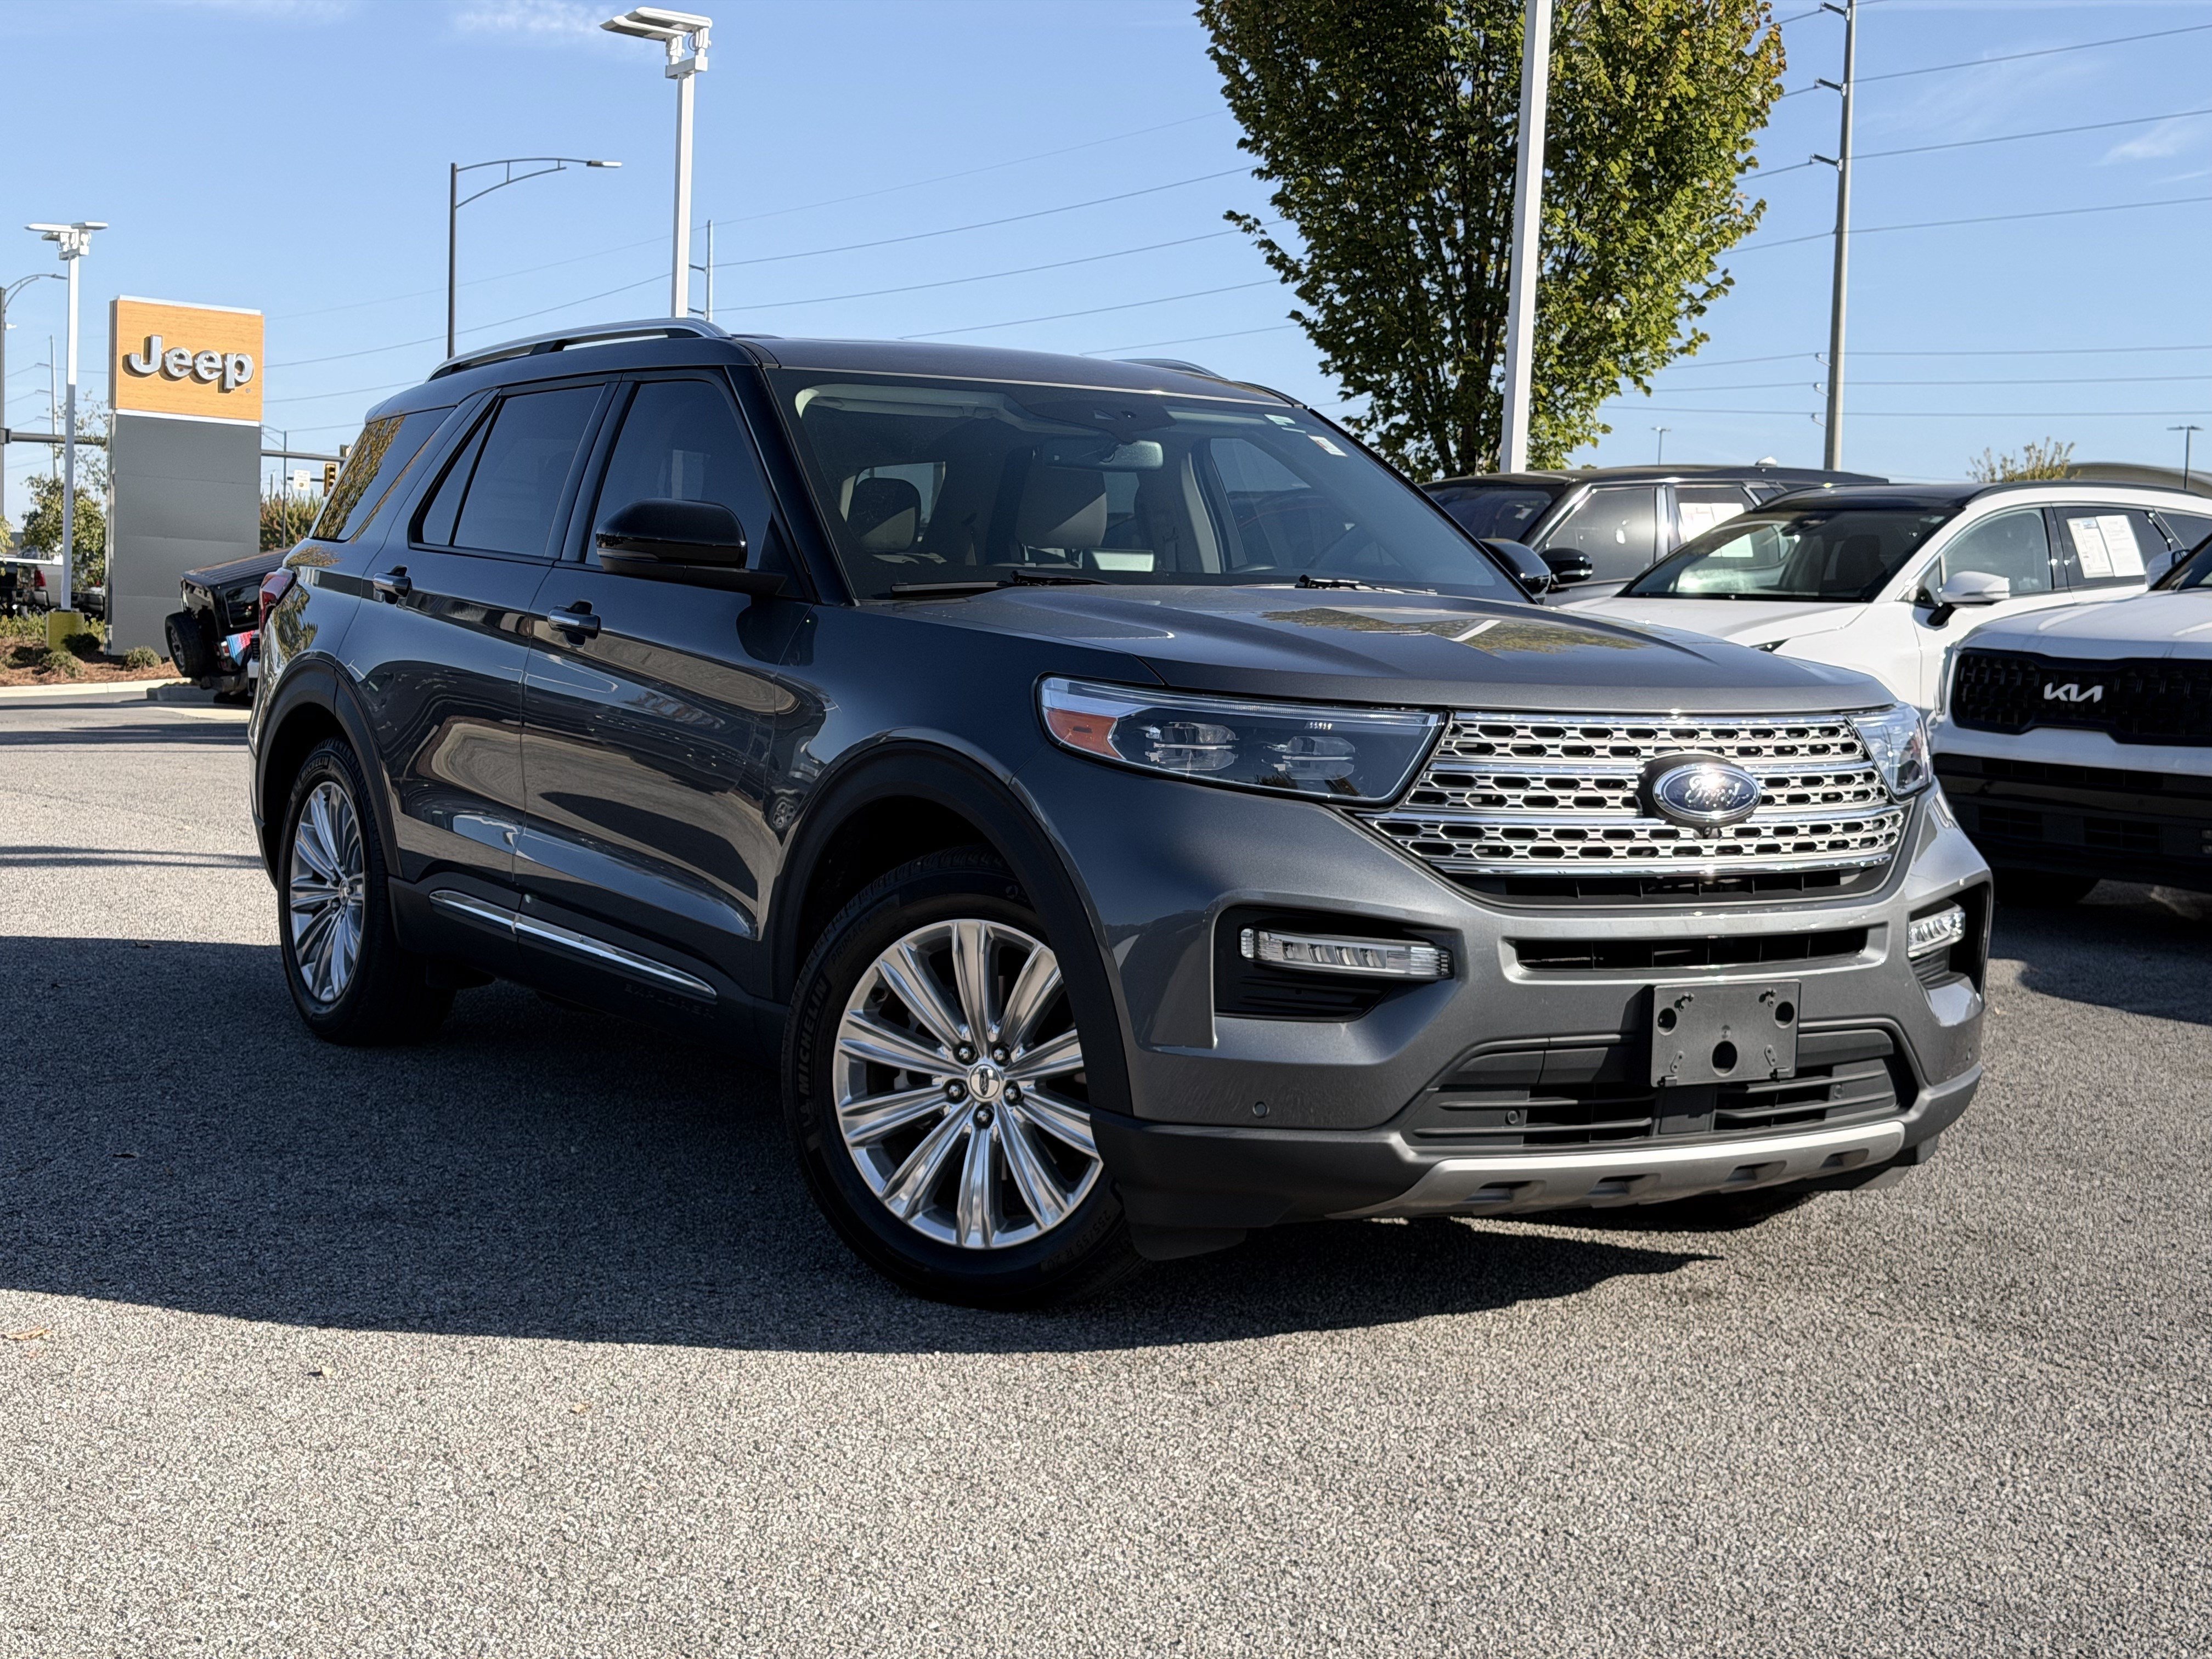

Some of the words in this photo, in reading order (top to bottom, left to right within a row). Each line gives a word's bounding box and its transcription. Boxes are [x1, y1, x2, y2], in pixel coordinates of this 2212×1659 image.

[129, 334, 254, 390] Jeep
[831, 913, 871, 965] PRIMACY
[798, 977, 828, 1096] MICHELIN
[1076, 1210, 1111, 1250] 255/55
